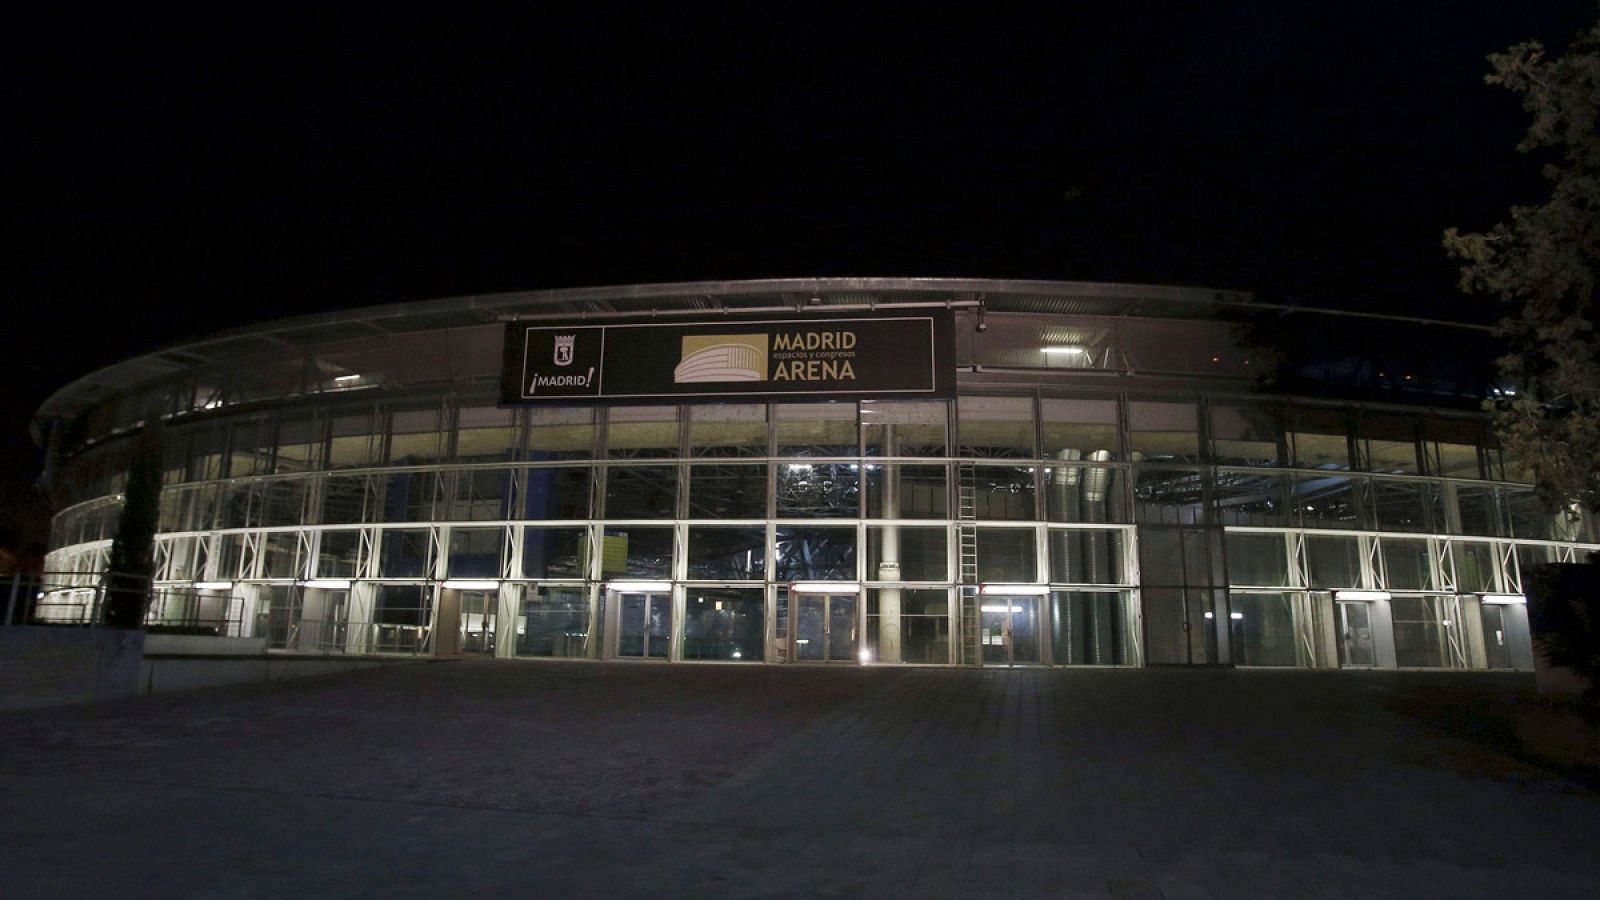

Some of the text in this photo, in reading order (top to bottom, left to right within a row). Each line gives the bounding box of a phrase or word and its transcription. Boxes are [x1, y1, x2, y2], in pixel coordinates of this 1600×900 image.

[773, 331, 857, 351] MADRID
[529, 367, 595, 394] ¡MADRID!
[773, 359, 857, 381] ARENA
